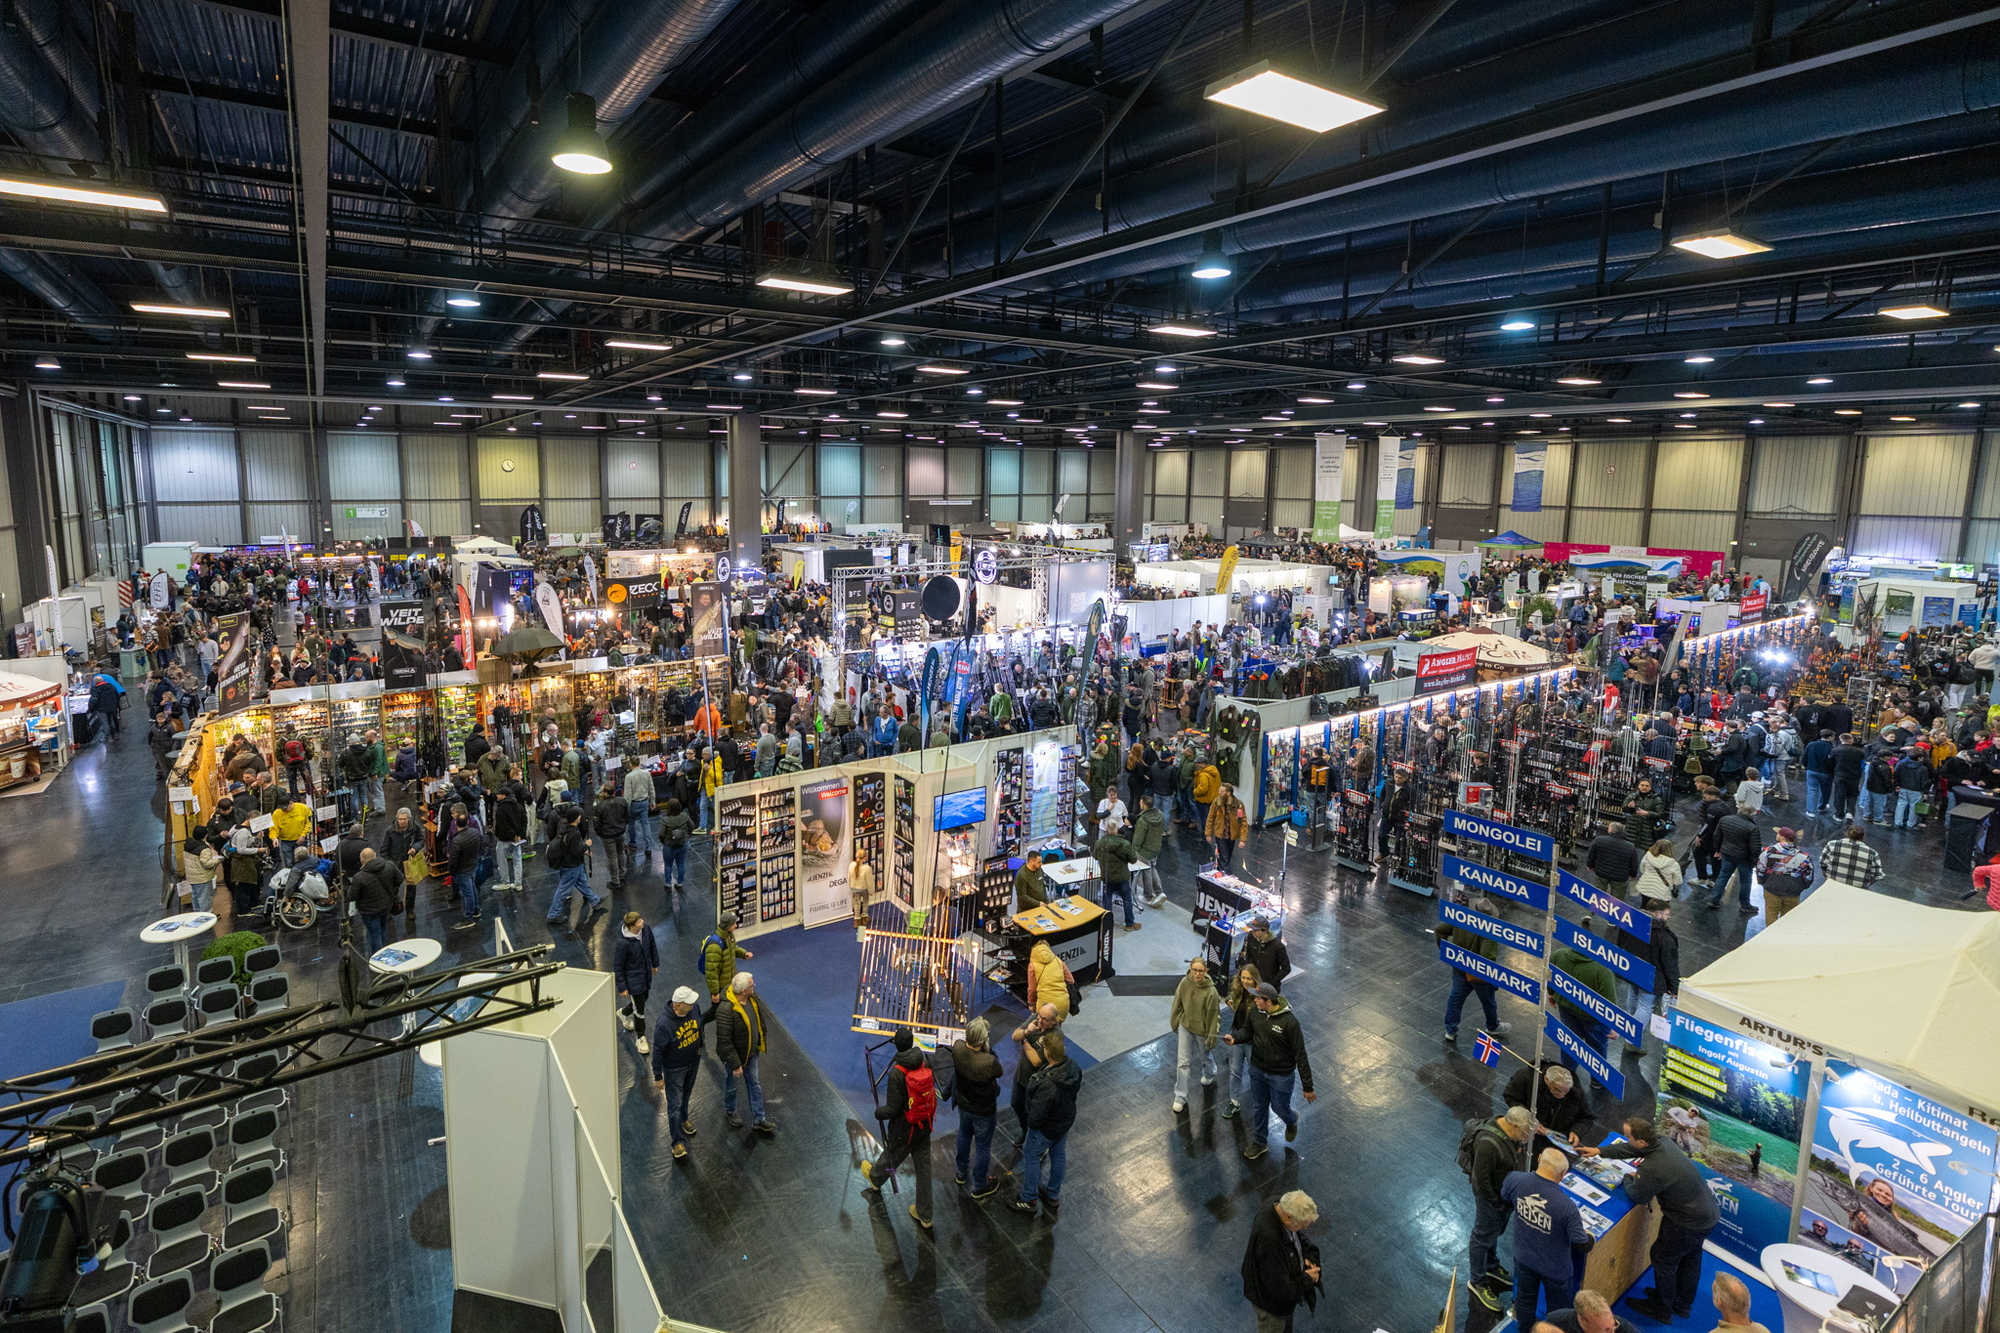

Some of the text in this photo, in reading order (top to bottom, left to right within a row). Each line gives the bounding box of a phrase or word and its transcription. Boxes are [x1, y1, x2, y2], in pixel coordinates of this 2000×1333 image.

[349, 509, 353, 517] 1
[153, 581, 162, 602] EFFA
[380, 616, 424, 626] WILDE
[389, 608, 422, 618] VEIT
[233, 661, 246, 674] NEW
[1431, 652, 1474, 667] ANGLER MARKT
[220, 667, 250, 689] GENERATION
[802, 783, 840, 795] Willkommen
[820, 788, 847, 798] Welcome
[1454, 817, 1541, 853] MONGOLEI
[812, 872, 829, 881] JENZI
[829, 878, 848, 888] DEGA
[1459, 865, 1530, 899] KANADA
[1569, 882, 1634, 928] ALASKA
[1444, 905, 1538, 951] NORWEGEN
[1573, 931, 1631, 972] ISLAND
[1445, 947, 1533, 996] DÄNEMARK
[1554, 974, 1637, 1038] SCHWEDEN
[1739, 1016, 1824, 1057] ARTUR'S
[1556, 1028, 1610, 1081] SPANIEN
[1668, 1047, 1720, 1078] Österreich
[1698, 1045, 1769, 1080] Ingolf Augustin
[1728, 1050, 1739, 1058] mit
[1666, 1071, 1715, 1099] Slowenien
[1667, 1060, 1727, 1093] Deutschland
[1873, 1094, 1885, 1106] u.
[1889, 1099, 1992, 1156] Heilbuttangeln
[1917, 1099, 1969, 1132] Kitimat
[1875, 1162, 1983, 1221] Geführte Tour
[1892, 1158, 1900, 1171] 2
[1919, 1172, 1928, 1184] 6
[1933, 1180, 1984, 1211] Angler
[1517, 1199, 1552, 1231] REISEN
